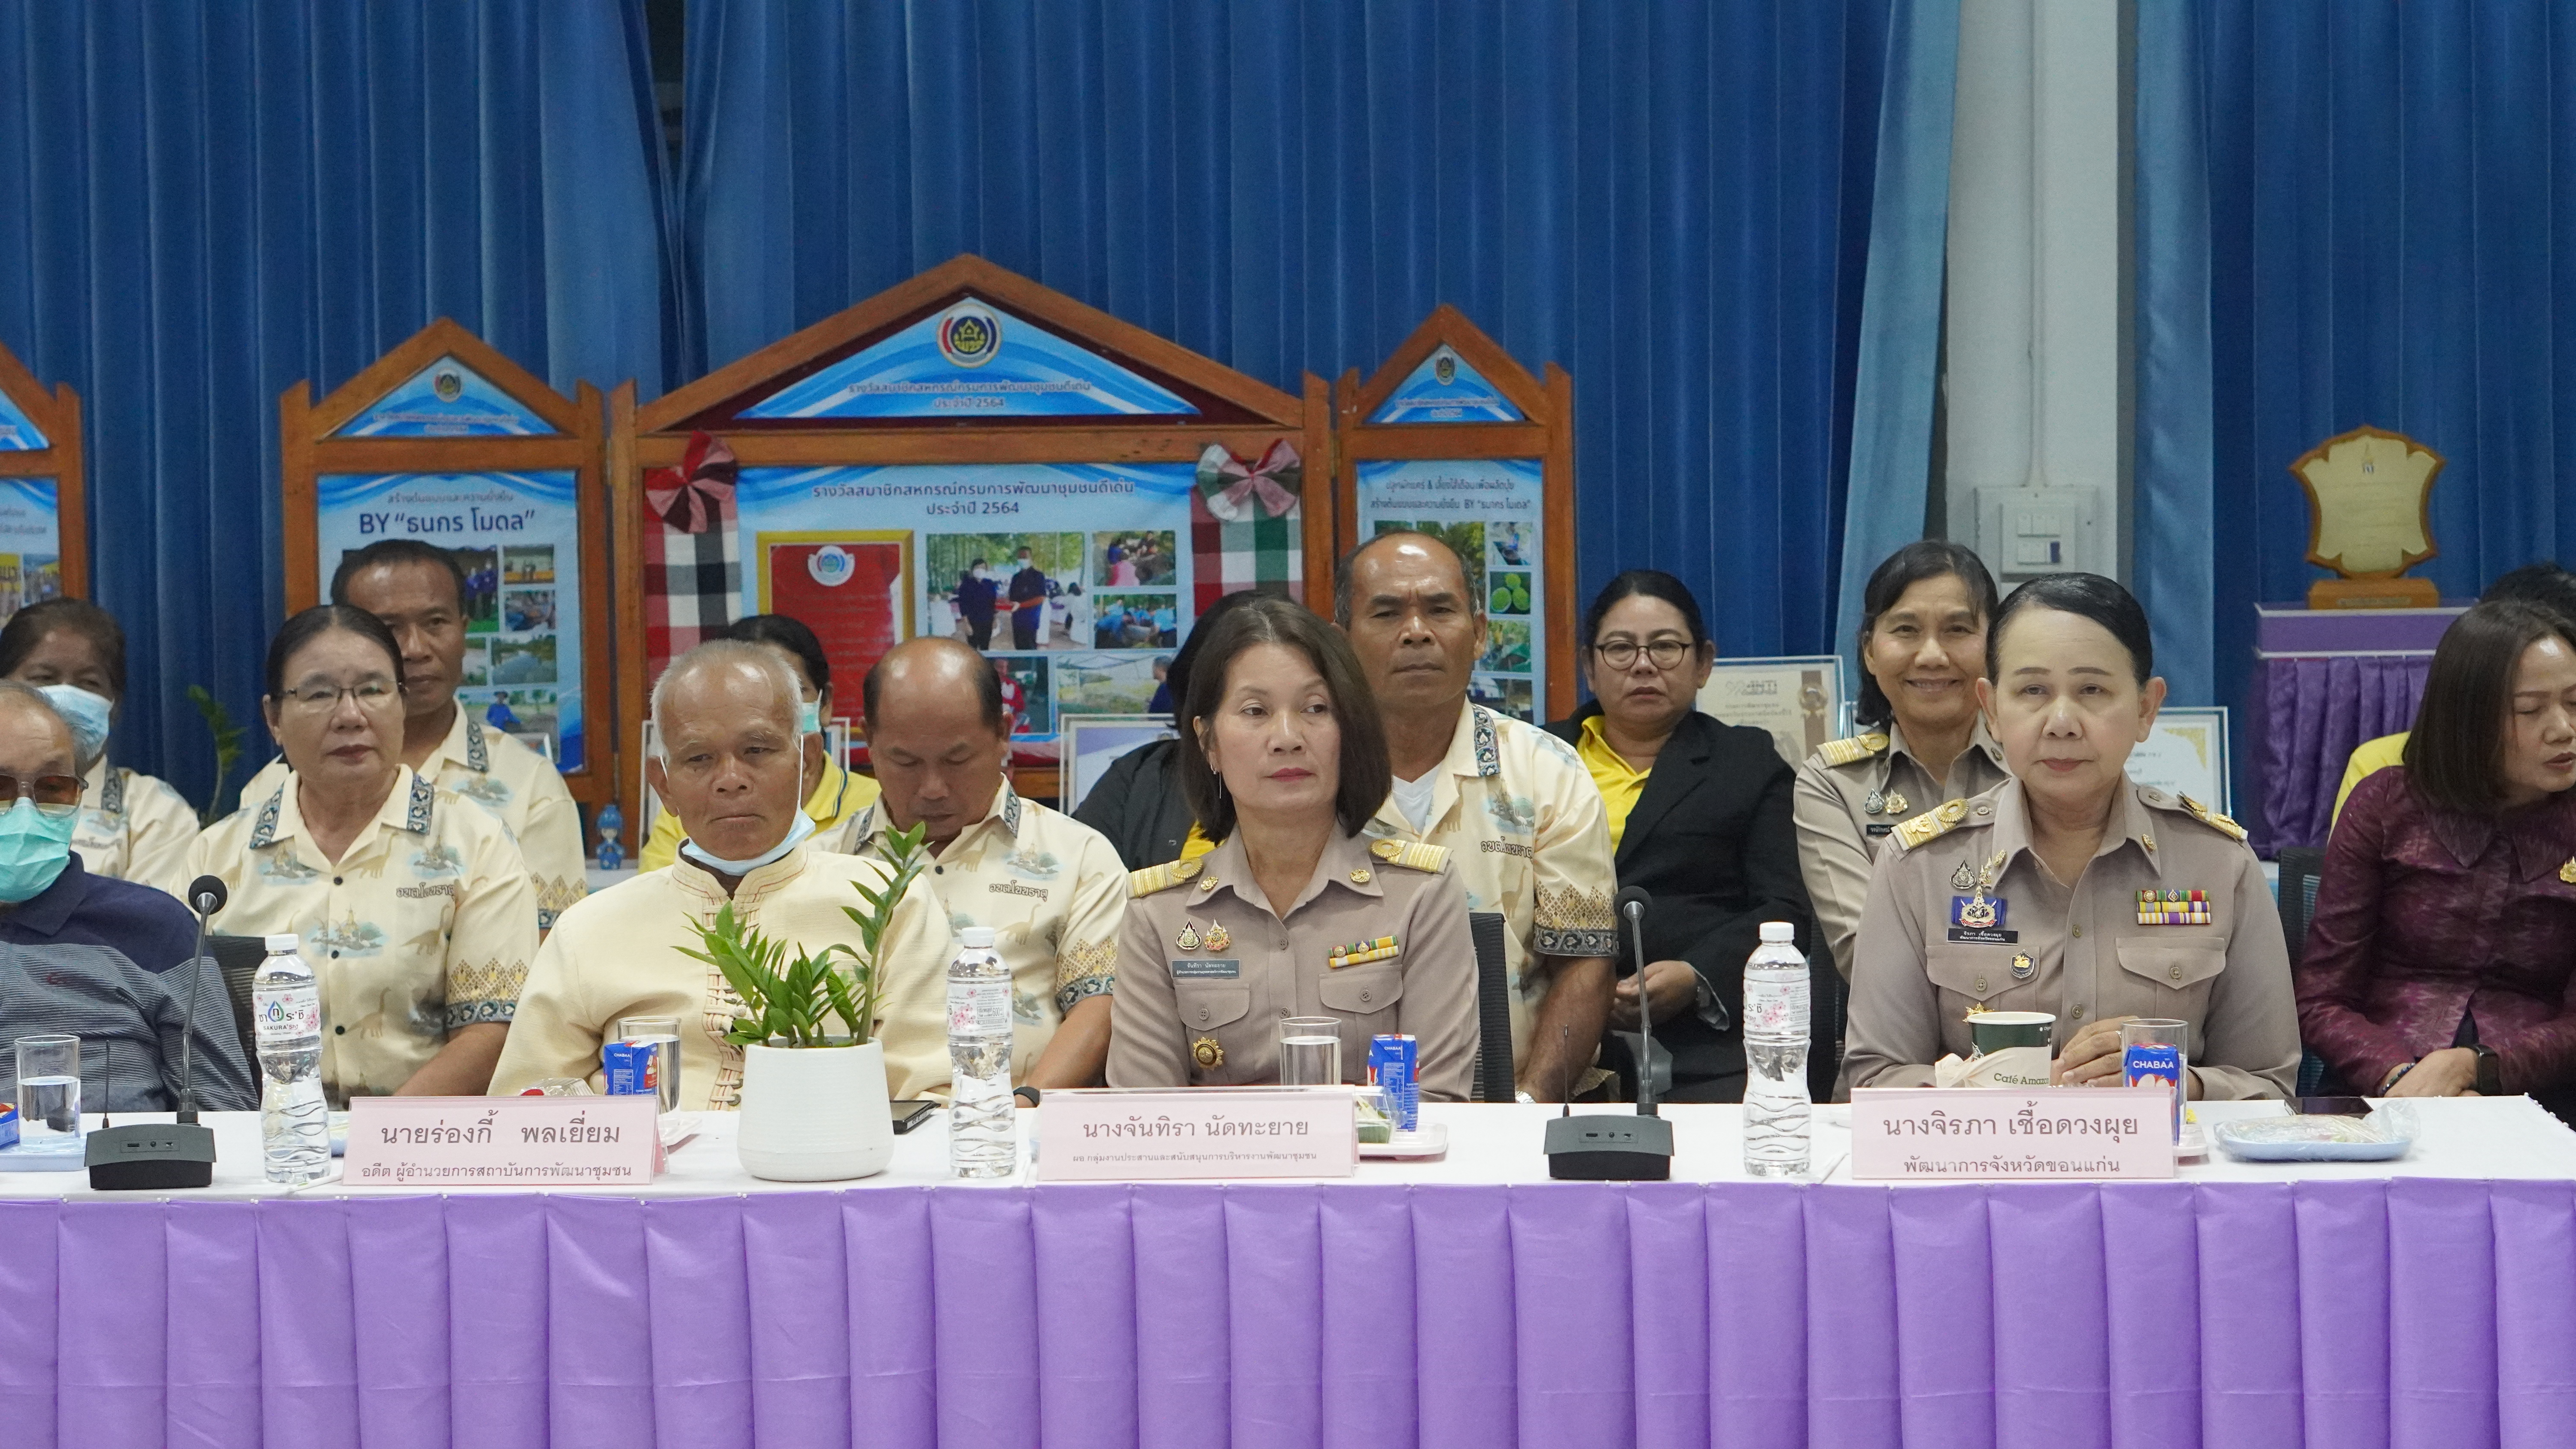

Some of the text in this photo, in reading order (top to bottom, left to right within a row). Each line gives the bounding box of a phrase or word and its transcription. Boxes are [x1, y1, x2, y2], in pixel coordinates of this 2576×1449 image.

[976, 397, 1004, 407] 2564
[813, 478, 1134, 497] รางวัลสมาชิกสหกรณ์กรมการพัฒนาชุมชนดีเด่น
[927, 500, 1019, 515] ประจำปี 2564
[1464, 499, 1474, 509] BY
[360, 513, 389, 534] BY
[2132, 1060, 2174, 1069] CHABAA
[1994, 1073, 2018, 1084] Café
[381, 1109, 620, 1143] นายร่องกี้ พลเยี่ยม
[1083, 1115, 1309, 1137] นางจันทิรา นัดทะยาย
[1883, 1100, 2138, 1143] นางจิรภา เชื้อดวงผุย
[361, 1162, 632, 1182] อดีต ผู้อำนวยการสถาบันการพัฒนาชุมชน
[1904, 1155, 2120, 1173] พัฒนาการจังหวัดขอนแก่น
